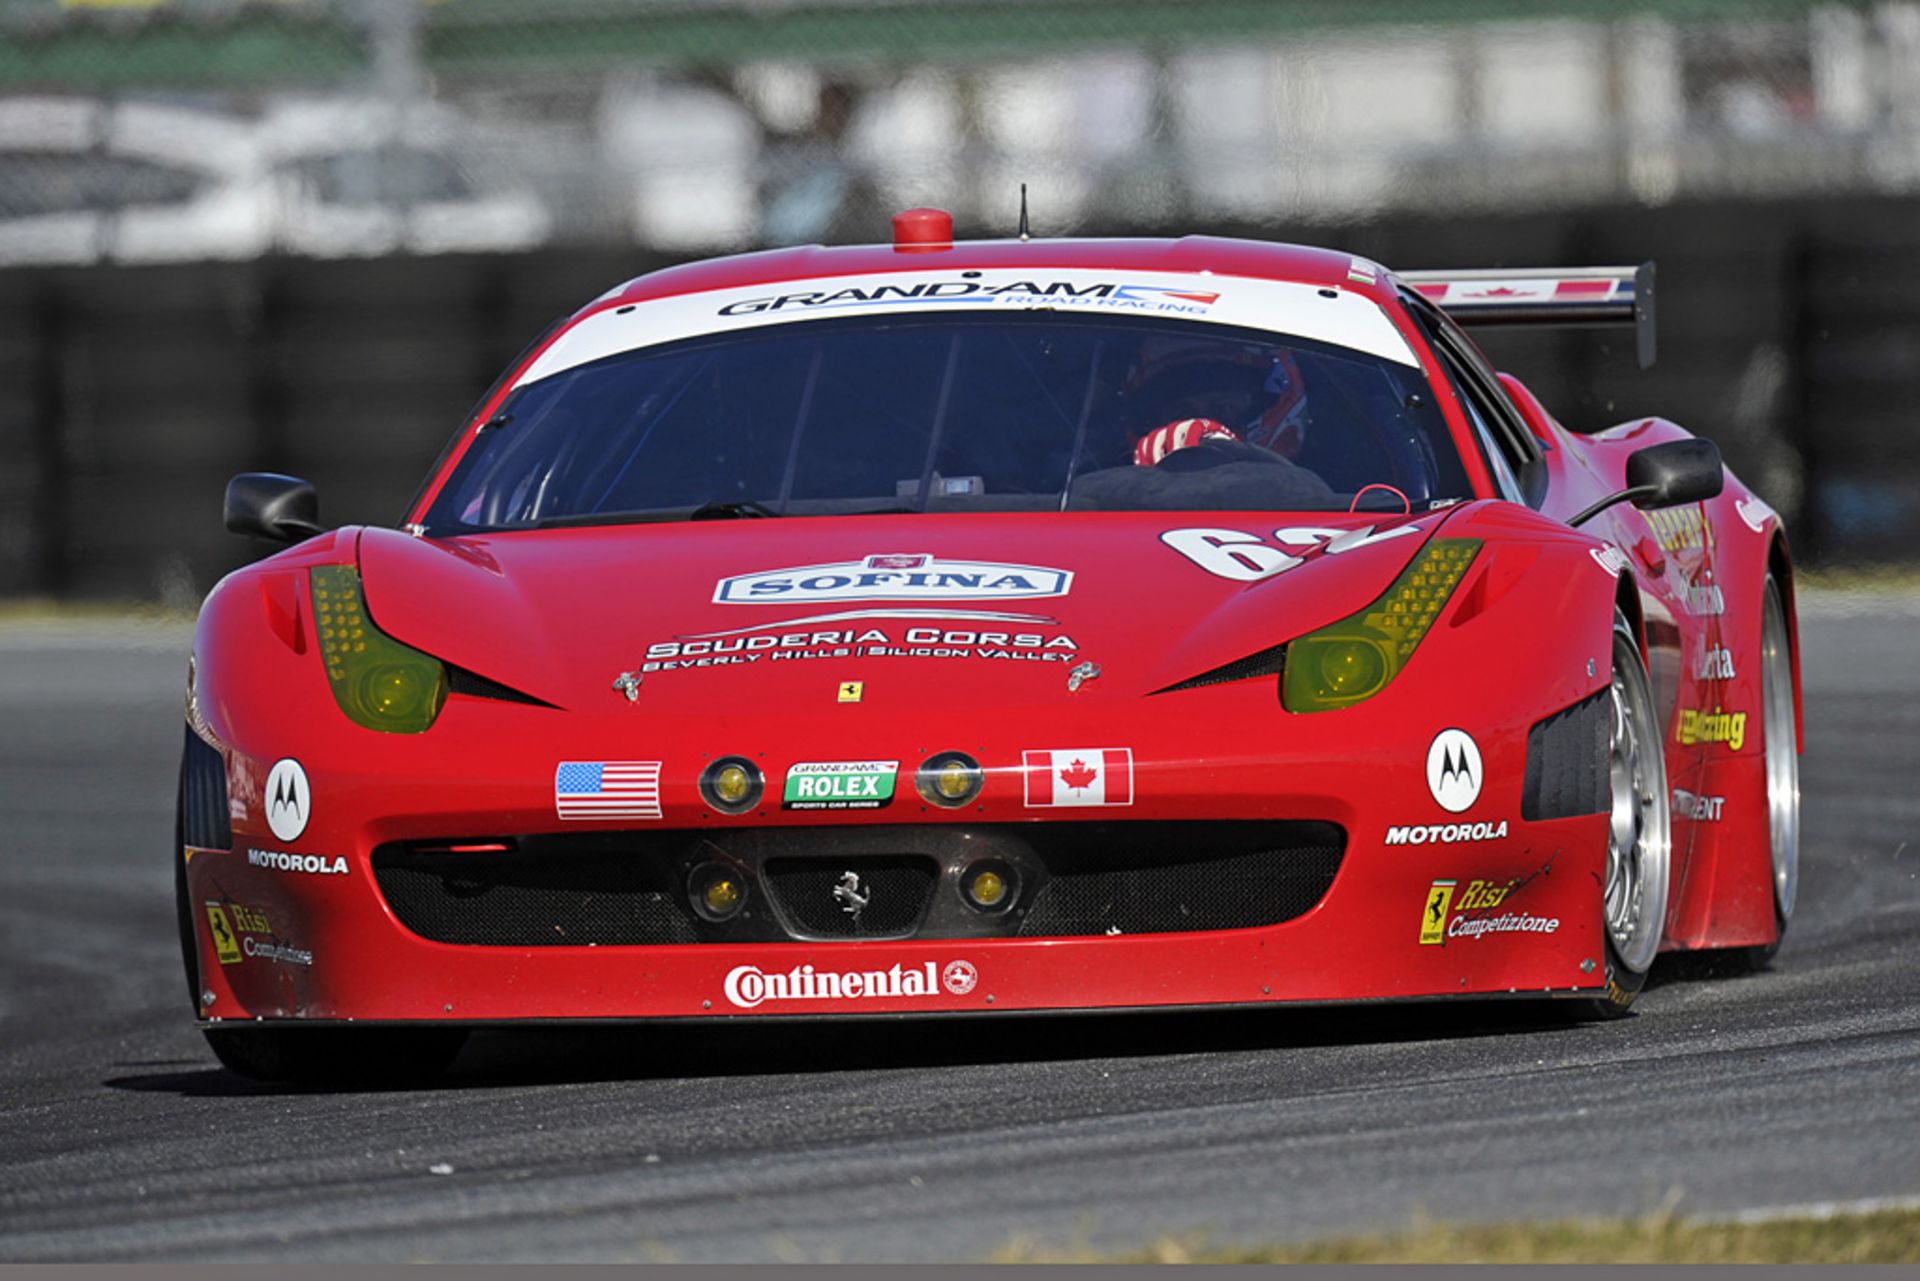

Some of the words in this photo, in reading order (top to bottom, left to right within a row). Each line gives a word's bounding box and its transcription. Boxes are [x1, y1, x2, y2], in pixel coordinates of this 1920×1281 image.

[717, 281, 1116, 316] GRAND-AM
[1004, 295, 1091, 305] ROAD
[1096, 298, 1208, 314] RACING
[1158, 527, 1424, 582] 62
[749, 571, 1039, 597] SOFINA
[644, 628, 889, 660] SCUDERIA
[905, 627, 1079, 650] CORSA
[641, 651, 761, 673] BEVERLY
[771, 646, 852, 660] HILLS
[867, 645, 970, 658] SILICON
[975, 647, 1078, 663] VALLEY
[797, 775, 880, 797] ROLEX
[790, 801, 827, 809] SPORTS
[828, 801, 848, 809] CAR
[848, 800, 880, 808] SERIES
[1384, 820, 1509, 845] MOTOROLA
[247, 848, 349, 874] MOTOROLA
[1454, 879, 1515, 911] Risi
[229, 903, 273, 934] Risi
[1447, 911, 1560, 940] Competizione
[723, 960, 940, 1009] Continental
